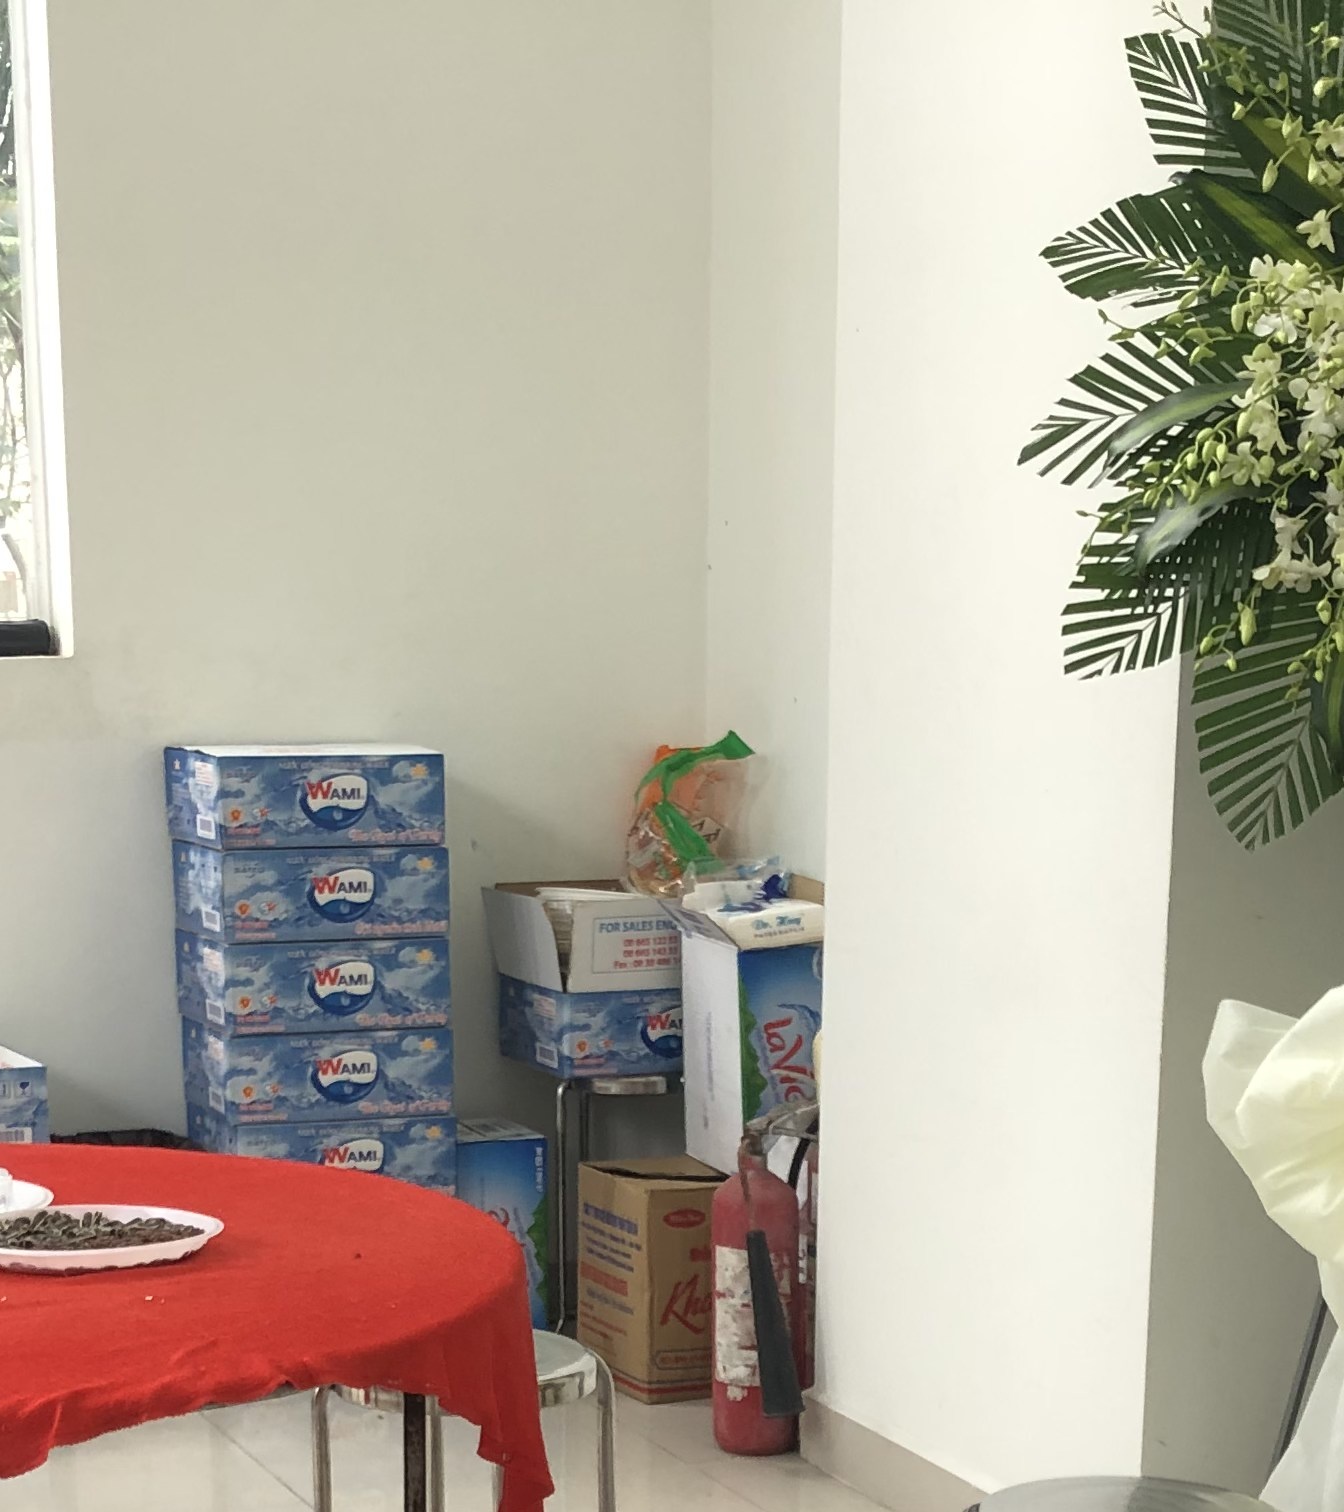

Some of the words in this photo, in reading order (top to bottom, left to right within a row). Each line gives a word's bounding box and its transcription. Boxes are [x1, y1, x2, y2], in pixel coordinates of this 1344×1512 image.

[305, 780, 362, 801] WAMI
[312, 876, 368, 895] WAMI
[599, 922, 621, 933] FOR
[623, 920, 654, 932] SALES
[313, 968, 369, 987] WAMI
[316, 1058, 372, 1076] WAMI
[323, 1146, 378, 1165] WAMI
